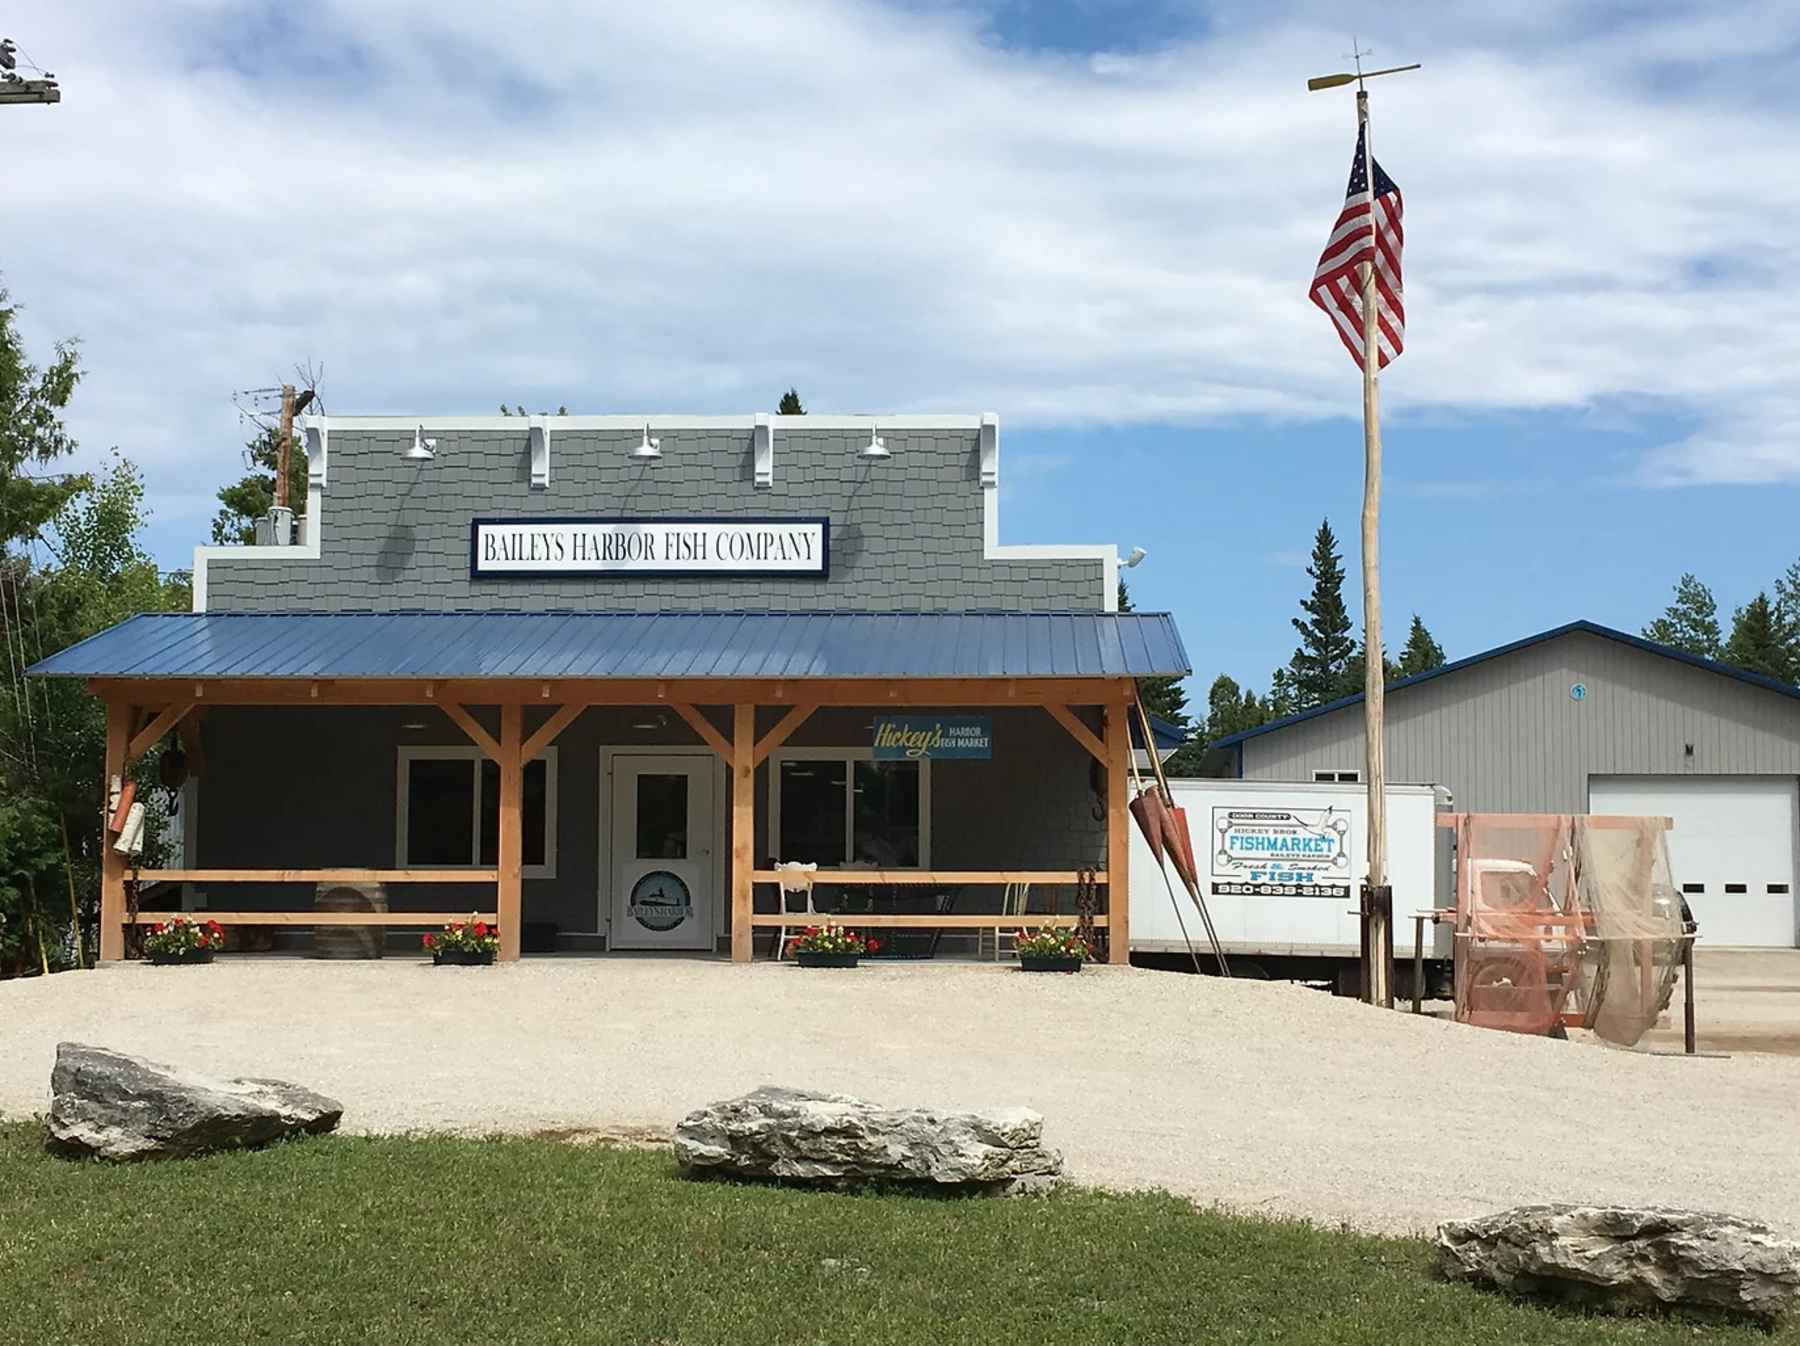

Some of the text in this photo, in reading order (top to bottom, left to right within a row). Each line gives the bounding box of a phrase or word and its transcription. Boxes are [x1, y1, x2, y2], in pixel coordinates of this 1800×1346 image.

[484, 531, 816, 561] BAILEYS HARBOR FISH COMPANY
[949, 727, 982, 737] HARBOR
[873, 723, 943, 758] Hickey's
[957, 737, 989, 748] MARKET
[1229, 835, 1335, 853] FISHMARKET
[1270, 862, 1282, 870] &
[1250, 871, 1314, 882] FISH
